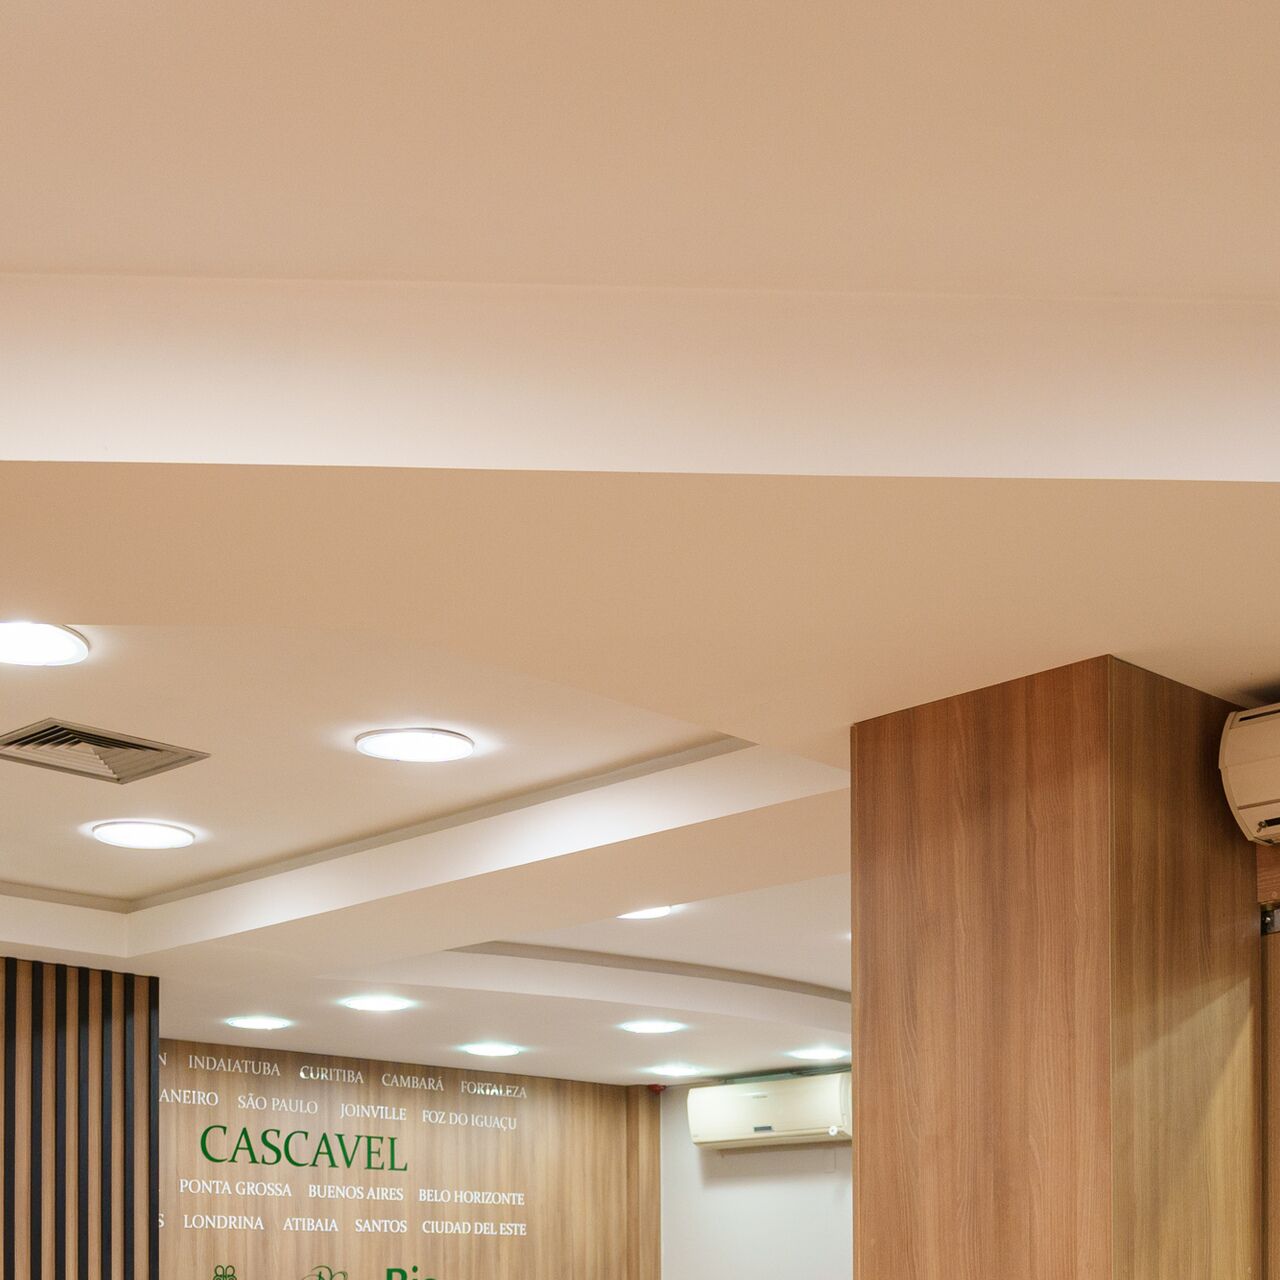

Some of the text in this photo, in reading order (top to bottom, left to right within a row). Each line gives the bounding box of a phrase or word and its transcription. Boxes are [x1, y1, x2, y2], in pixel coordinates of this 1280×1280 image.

[189, 1054, 281, 1076] INDAIATUBA
[299, 1065, 364, 1084] CURITIBA
[381, 1073, 445, 1091] CAMBARÁ
[461, 1080, 527, 1098] FORTALEZA
[238, 1092, 267, 1110] SÃO
[271, 1098, 318, 1114] PAULO
[339, 1103, 407, 1121] JOINVILLE
[422, 1109, 446, 1124] FOZ
[449, 1113, 468, 1126] DO
[471, 1114, 517, 1131] IGUAÇU
[200, 1124, 408, 1172] CASCAVEL
[179, 1178, 525, 1206] PONTA GROSSA BUENOS AIRES BELO HORIZONTE
[183, 1214, 527, 1236] LONDRINA ATIBAIA SANTOS CIUDAD DEL ESTE
